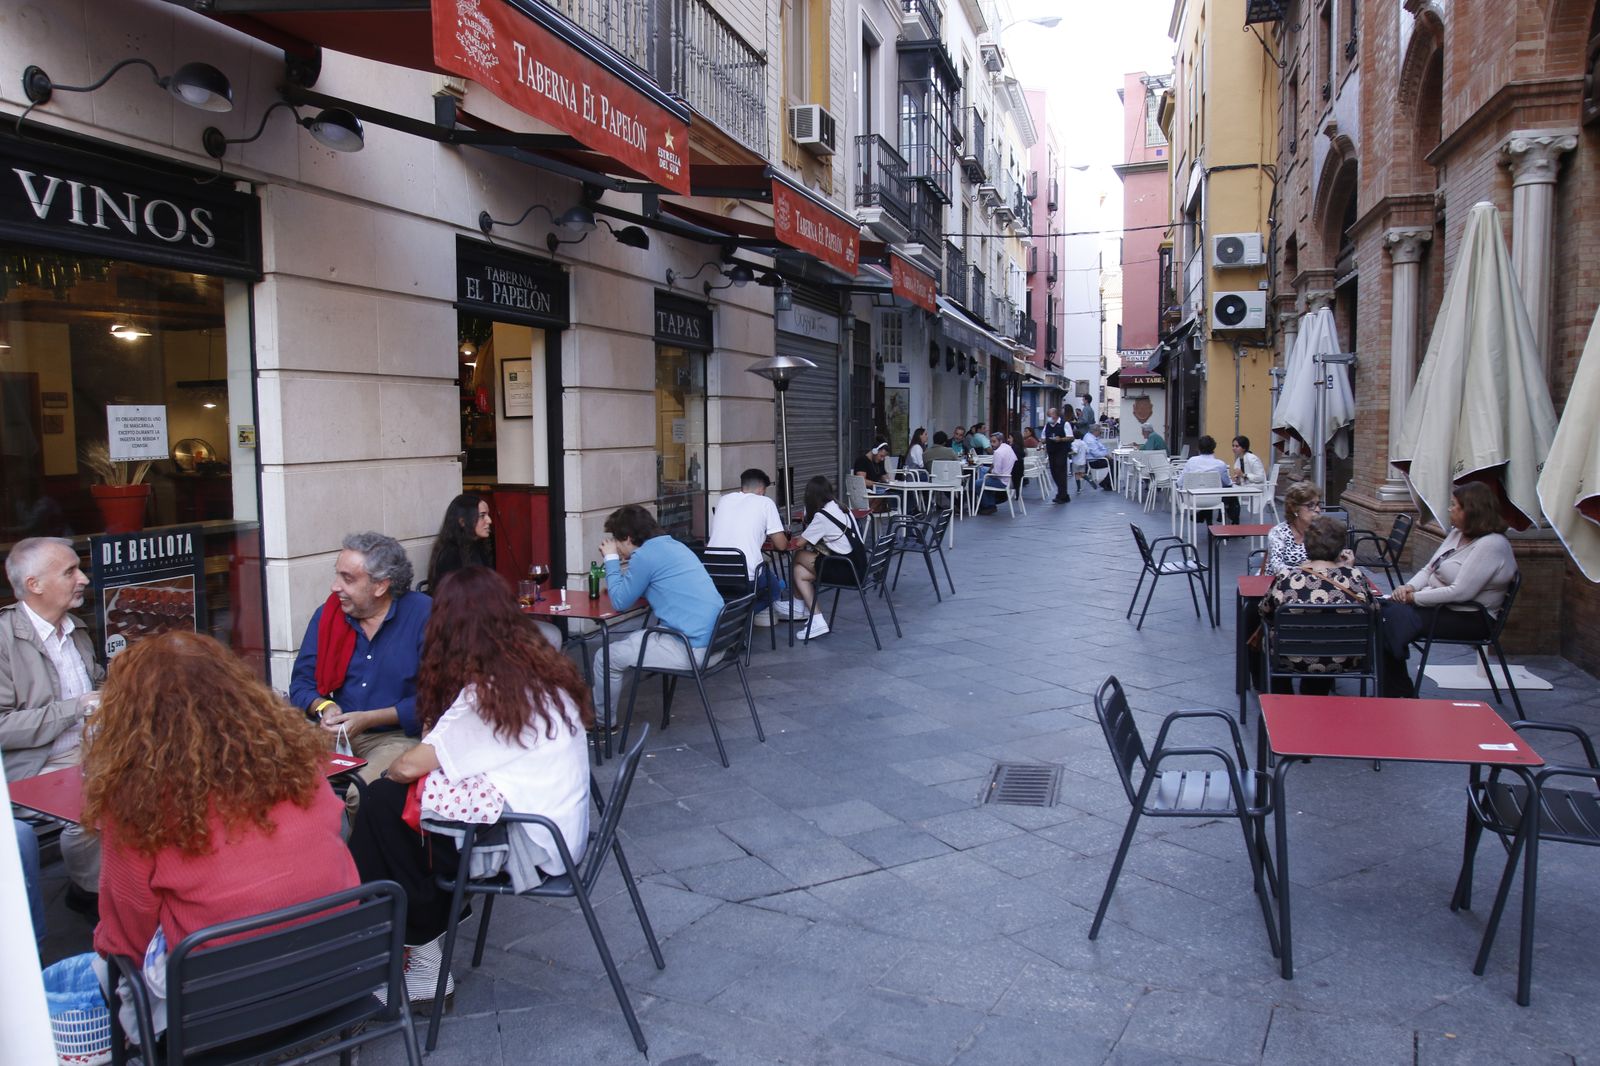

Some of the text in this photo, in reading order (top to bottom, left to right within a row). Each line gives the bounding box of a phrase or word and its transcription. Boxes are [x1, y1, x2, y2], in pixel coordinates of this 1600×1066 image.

[513, 41, 578, 114] TABERNA
[582, 82, 598, 125] EL
[600, 94, 647, 153] PAPELÓN
[657, 146, 681, 167] ESTRELLA
[659, 158, 680, 176] DEL SUR
[12, 168, 216, 248] VINOS
[485, 265, 535, 290] TABERNA
[465, 276, 551, 313] EL PAPELÓN
[656, 311, 700, 339] TAPAS
[102, 533, 193, 566] DE BELLOTA
